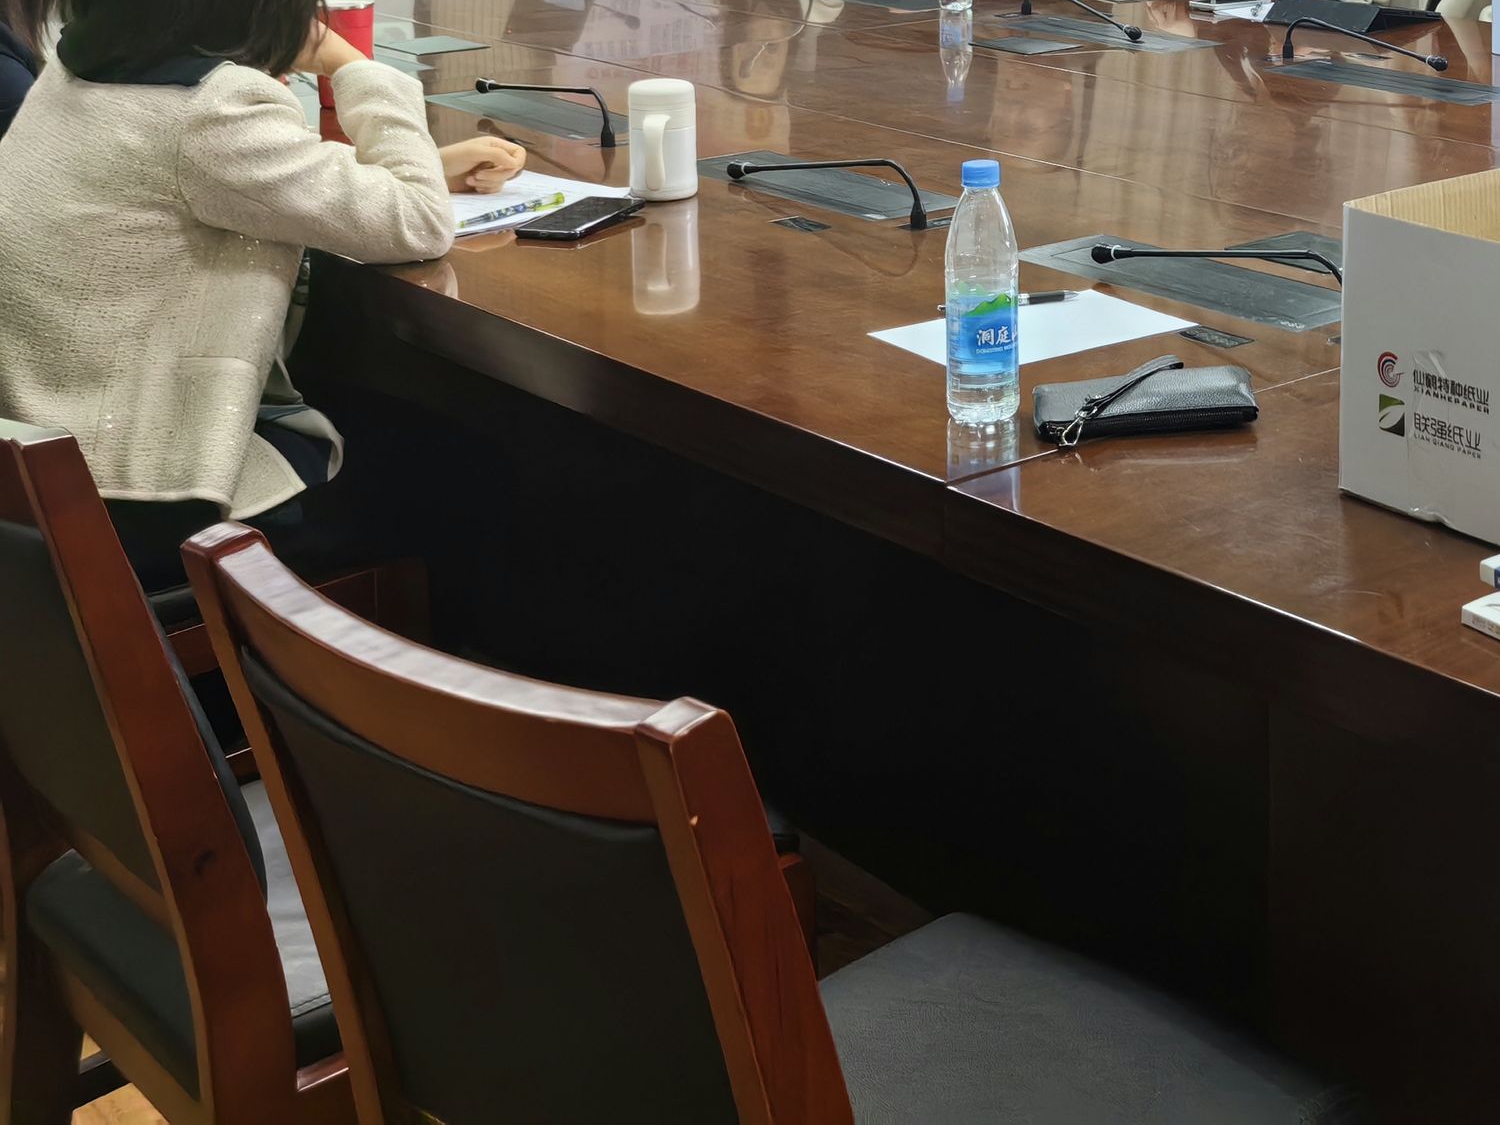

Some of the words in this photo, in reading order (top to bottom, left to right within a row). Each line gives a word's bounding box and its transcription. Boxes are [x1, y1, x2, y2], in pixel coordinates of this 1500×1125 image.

[1413, 411, 1481, 452] 联强纸业
[1457, 445, 1481, 459] PAPER
